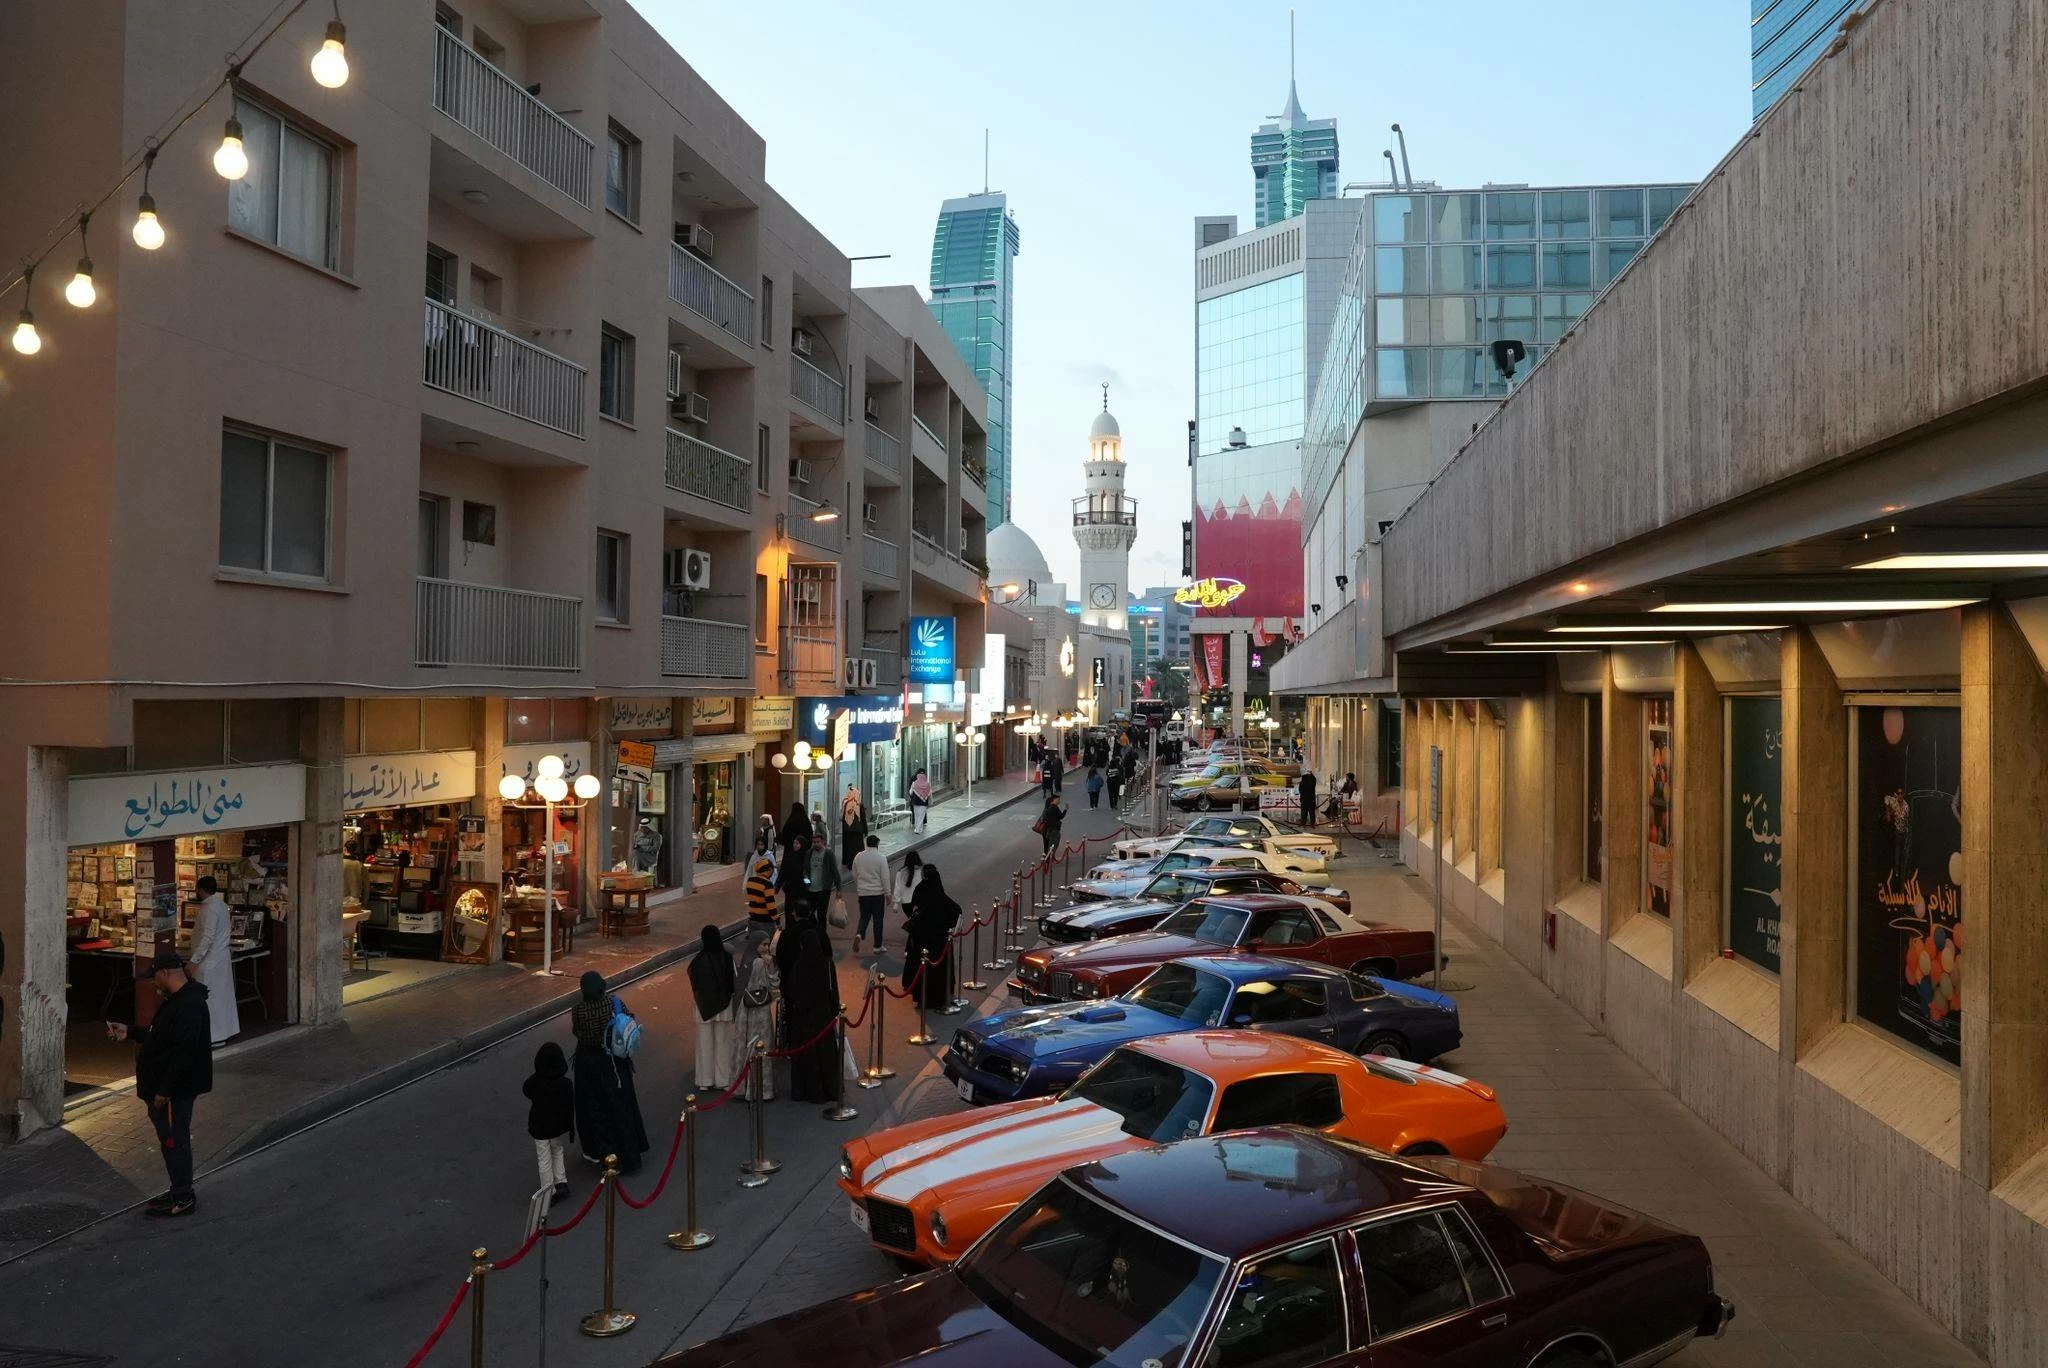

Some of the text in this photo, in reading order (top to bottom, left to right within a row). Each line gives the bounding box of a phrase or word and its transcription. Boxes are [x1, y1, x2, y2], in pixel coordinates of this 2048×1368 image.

[910, 657, 952, 665] International
[910, 665, 942, 674] Exchange
[410, 767, 441, 800] عالم
[124, 778, 201, 838] للطوابع
[1756, 916, 1766, 933] AL
